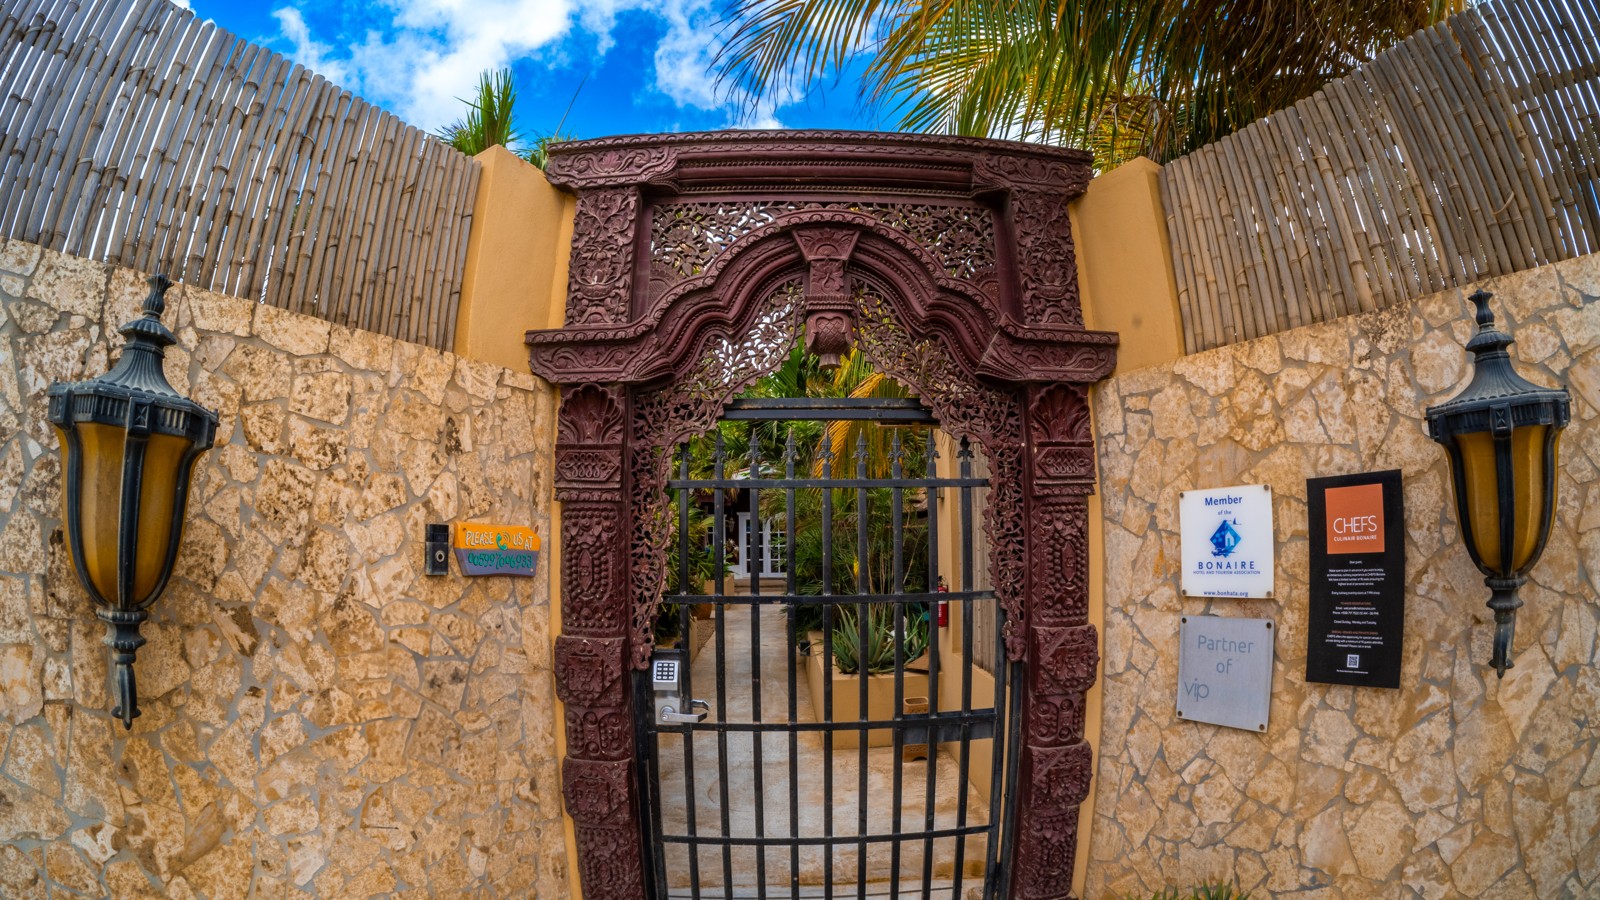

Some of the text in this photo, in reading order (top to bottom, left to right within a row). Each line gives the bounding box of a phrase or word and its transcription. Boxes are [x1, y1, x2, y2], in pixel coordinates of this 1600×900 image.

[1204, 495, 1243, 506] Member
[1333, 515, 1378, 534] CHEFS
[465, 531, 534, 551] PLEASE US AT
[1198, 561, 1255, 570] BONAIRE
[1197, 634, 1254, 653] Partner
[1216, 658, 1233, 674] of
[1184, 677, 1210, 702] vip
